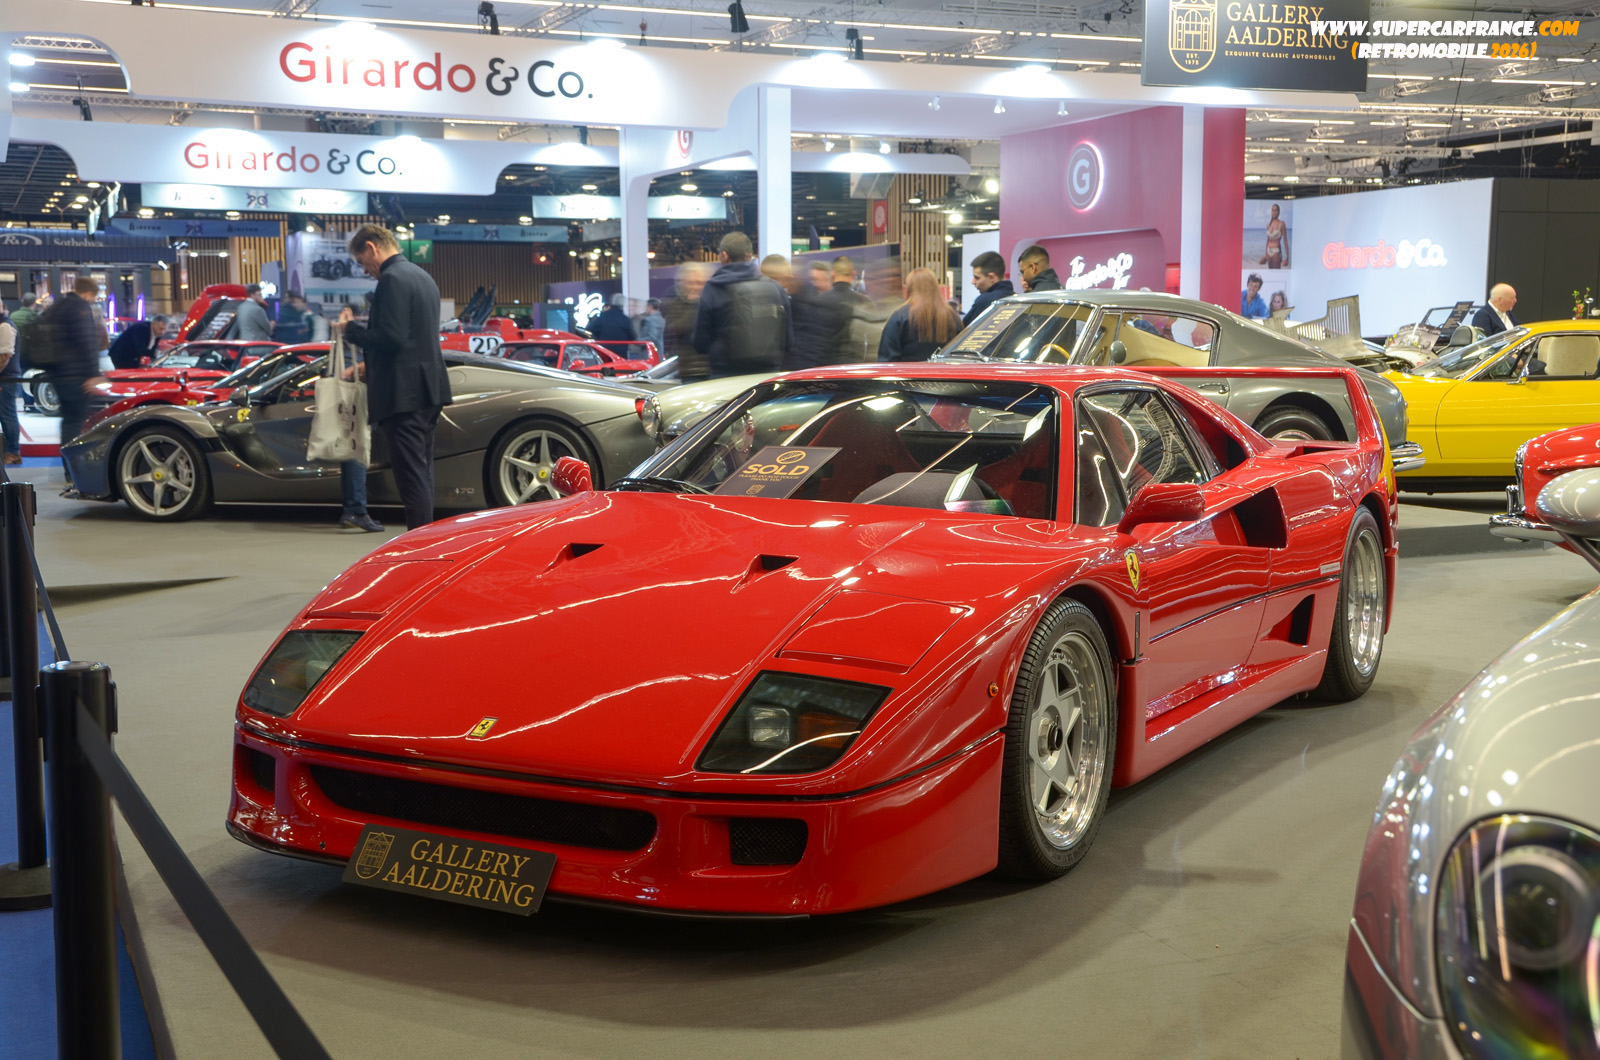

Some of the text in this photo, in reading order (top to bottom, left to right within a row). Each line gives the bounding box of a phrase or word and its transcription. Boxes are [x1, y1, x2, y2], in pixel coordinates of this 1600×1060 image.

[1226, 2, 1324, 25] GALLERY
[1225, 25, 1349, 49] AALDERING
[280, 41, 593, 99] Girardo & Co.
[1225, 50, 1260, 58] EXQUISITE
[184, 142, 403, 175] Girardo & Co.
[1073, 158, 1090, 195] G
[742, 463, 810, 476] SOLD
[410, 839, 531, 878] GALLERY
[382, 861, 535, 907] AALDERING
